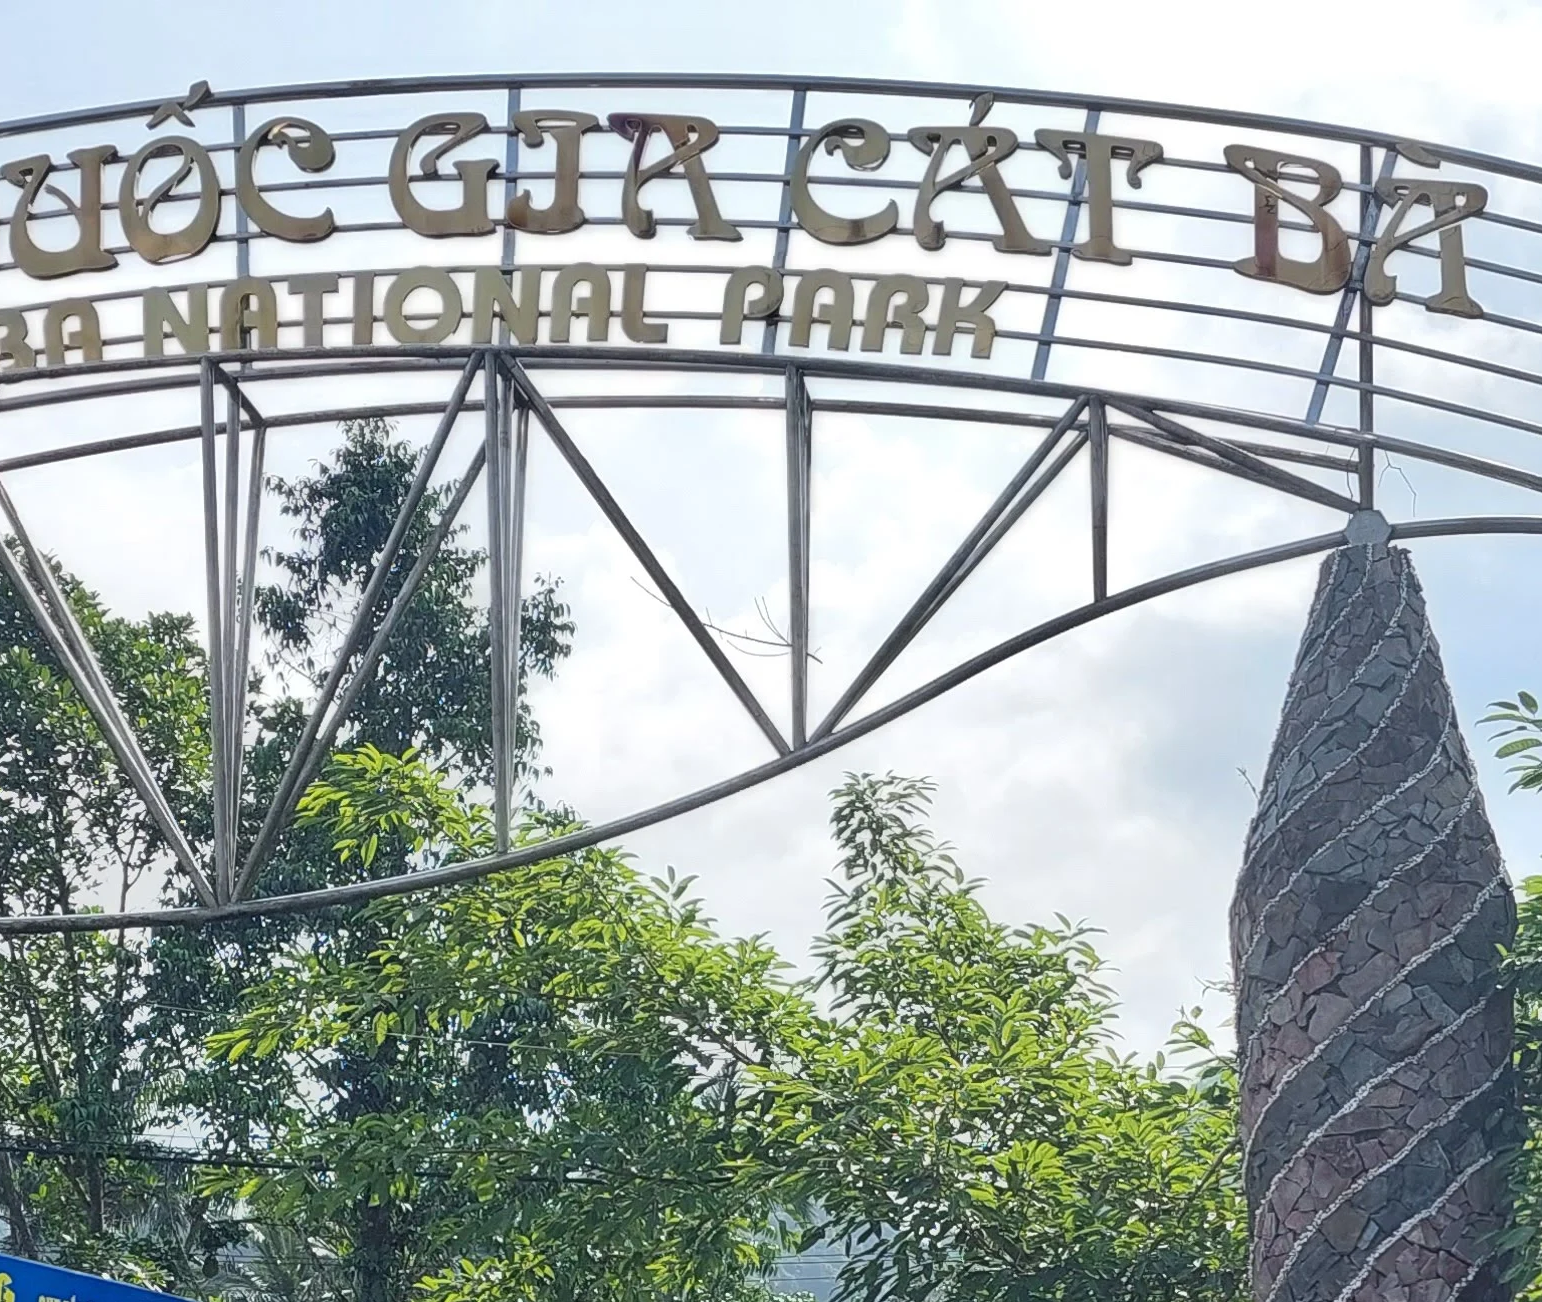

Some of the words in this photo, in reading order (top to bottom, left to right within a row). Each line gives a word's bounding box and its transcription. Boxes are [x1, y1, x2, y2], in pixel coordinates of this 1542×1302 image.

[387, 110, 744, 242] GIA
[790, 91, 1164, 266] CÁT
[1223, 143, 1489, 319] BÀ
[143, 262, 668, 357] NATIONAL
[721, 269, 1010, 360] PARK
